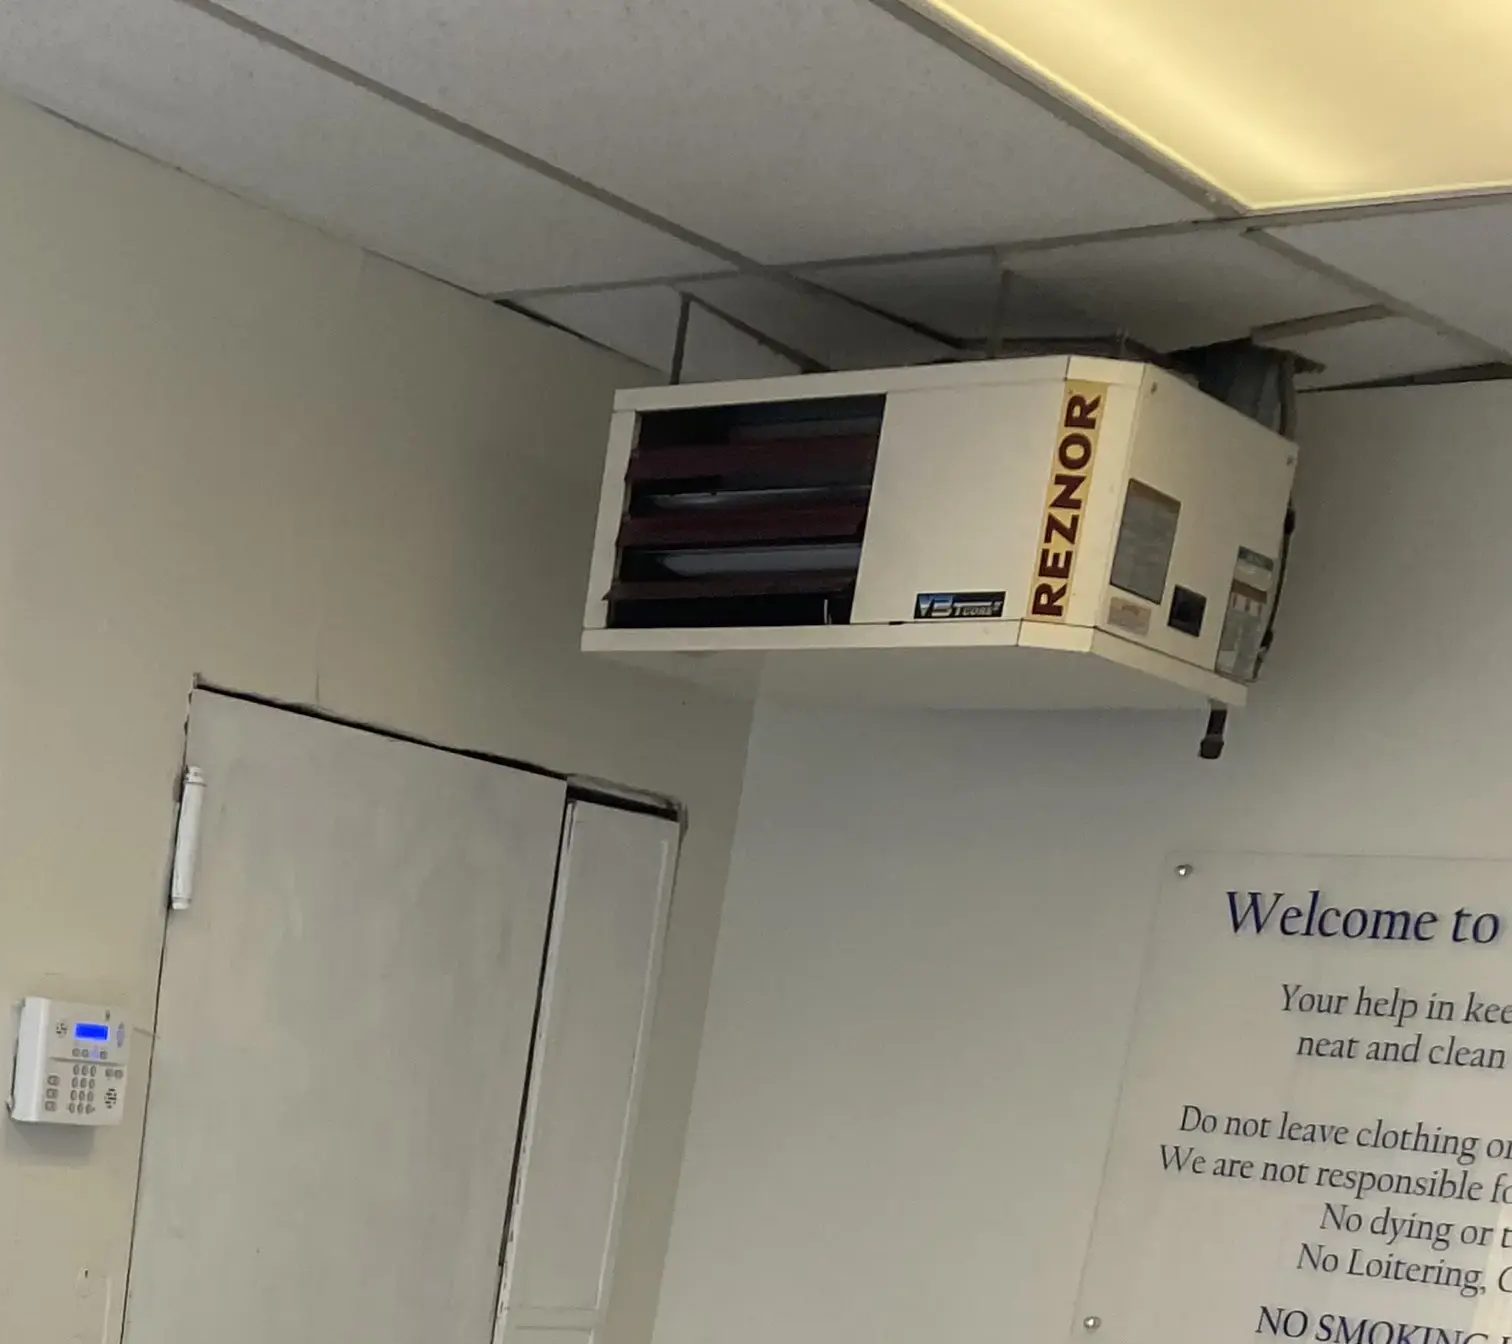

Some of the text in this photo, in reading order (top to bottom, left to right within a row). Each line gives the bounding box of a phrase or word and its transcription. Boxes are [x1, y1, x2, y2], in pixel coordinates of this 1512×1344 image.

[1033, 394, 1102, 617] REZNOR
[1226, 890, 1500, 944] Welcome to
[1282, 984, 1348, 1015] Your
[1354, 986, 1418, 1027] help
[1425, 993, 1454, 1021] in
[1296, 1034, 1505, 1069] neat and clean
[1179, 1105, 1217, 1133] Do
[1224, 1117, 1272, 1138] not
[1277, 1111, 1349, 1145] leave
[1356, 1119, 1480, 1165] clothing
[1160, 1145, 1206, 1174] We
[1212, 1159, 1254, 1179] are
[1260, 1162, 1309, 1184] not
[1315, 1168, 1483, 1201] responsible
[1320, 1203, 1362, 1232] No
[1370, 1207, 1455, 1251] dying
[1461, 1226, 1494, 1246] or
[1297, 1243, 1338, 1272] No
[1346, 1245, 1486, 1298] Loitering,
[1255, 1306, 1308, 1338] NO
